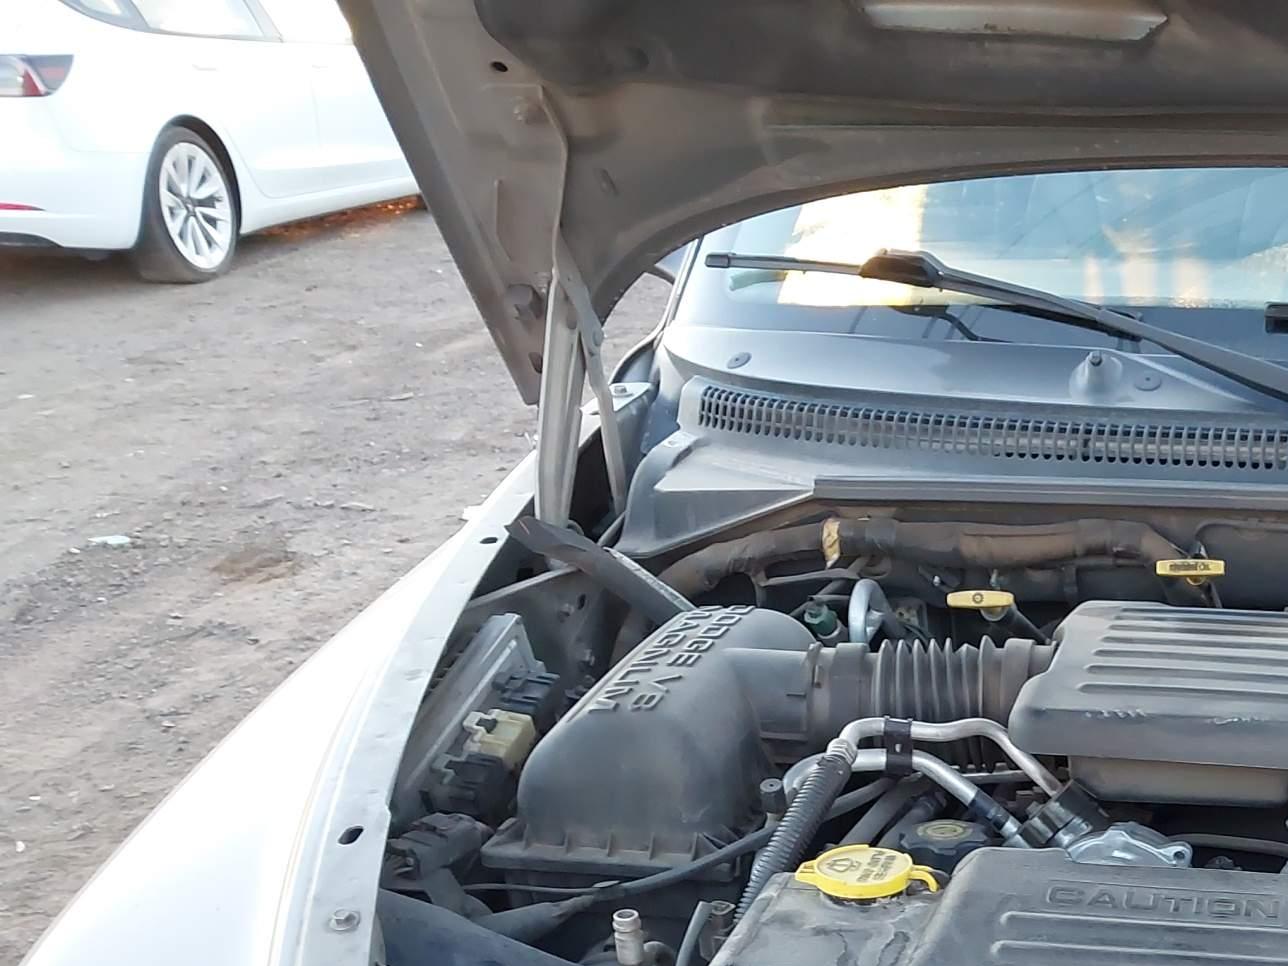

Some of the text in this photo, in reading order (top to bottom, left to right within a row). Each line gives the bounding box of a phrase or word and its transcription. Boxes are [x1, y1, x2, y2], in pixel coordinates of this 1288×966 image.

[587, 605, 723, 713] MAGNUM
[629, 605, 757, 711] DODGE V8
[1046, 886, 1281, 920] CAUTION
